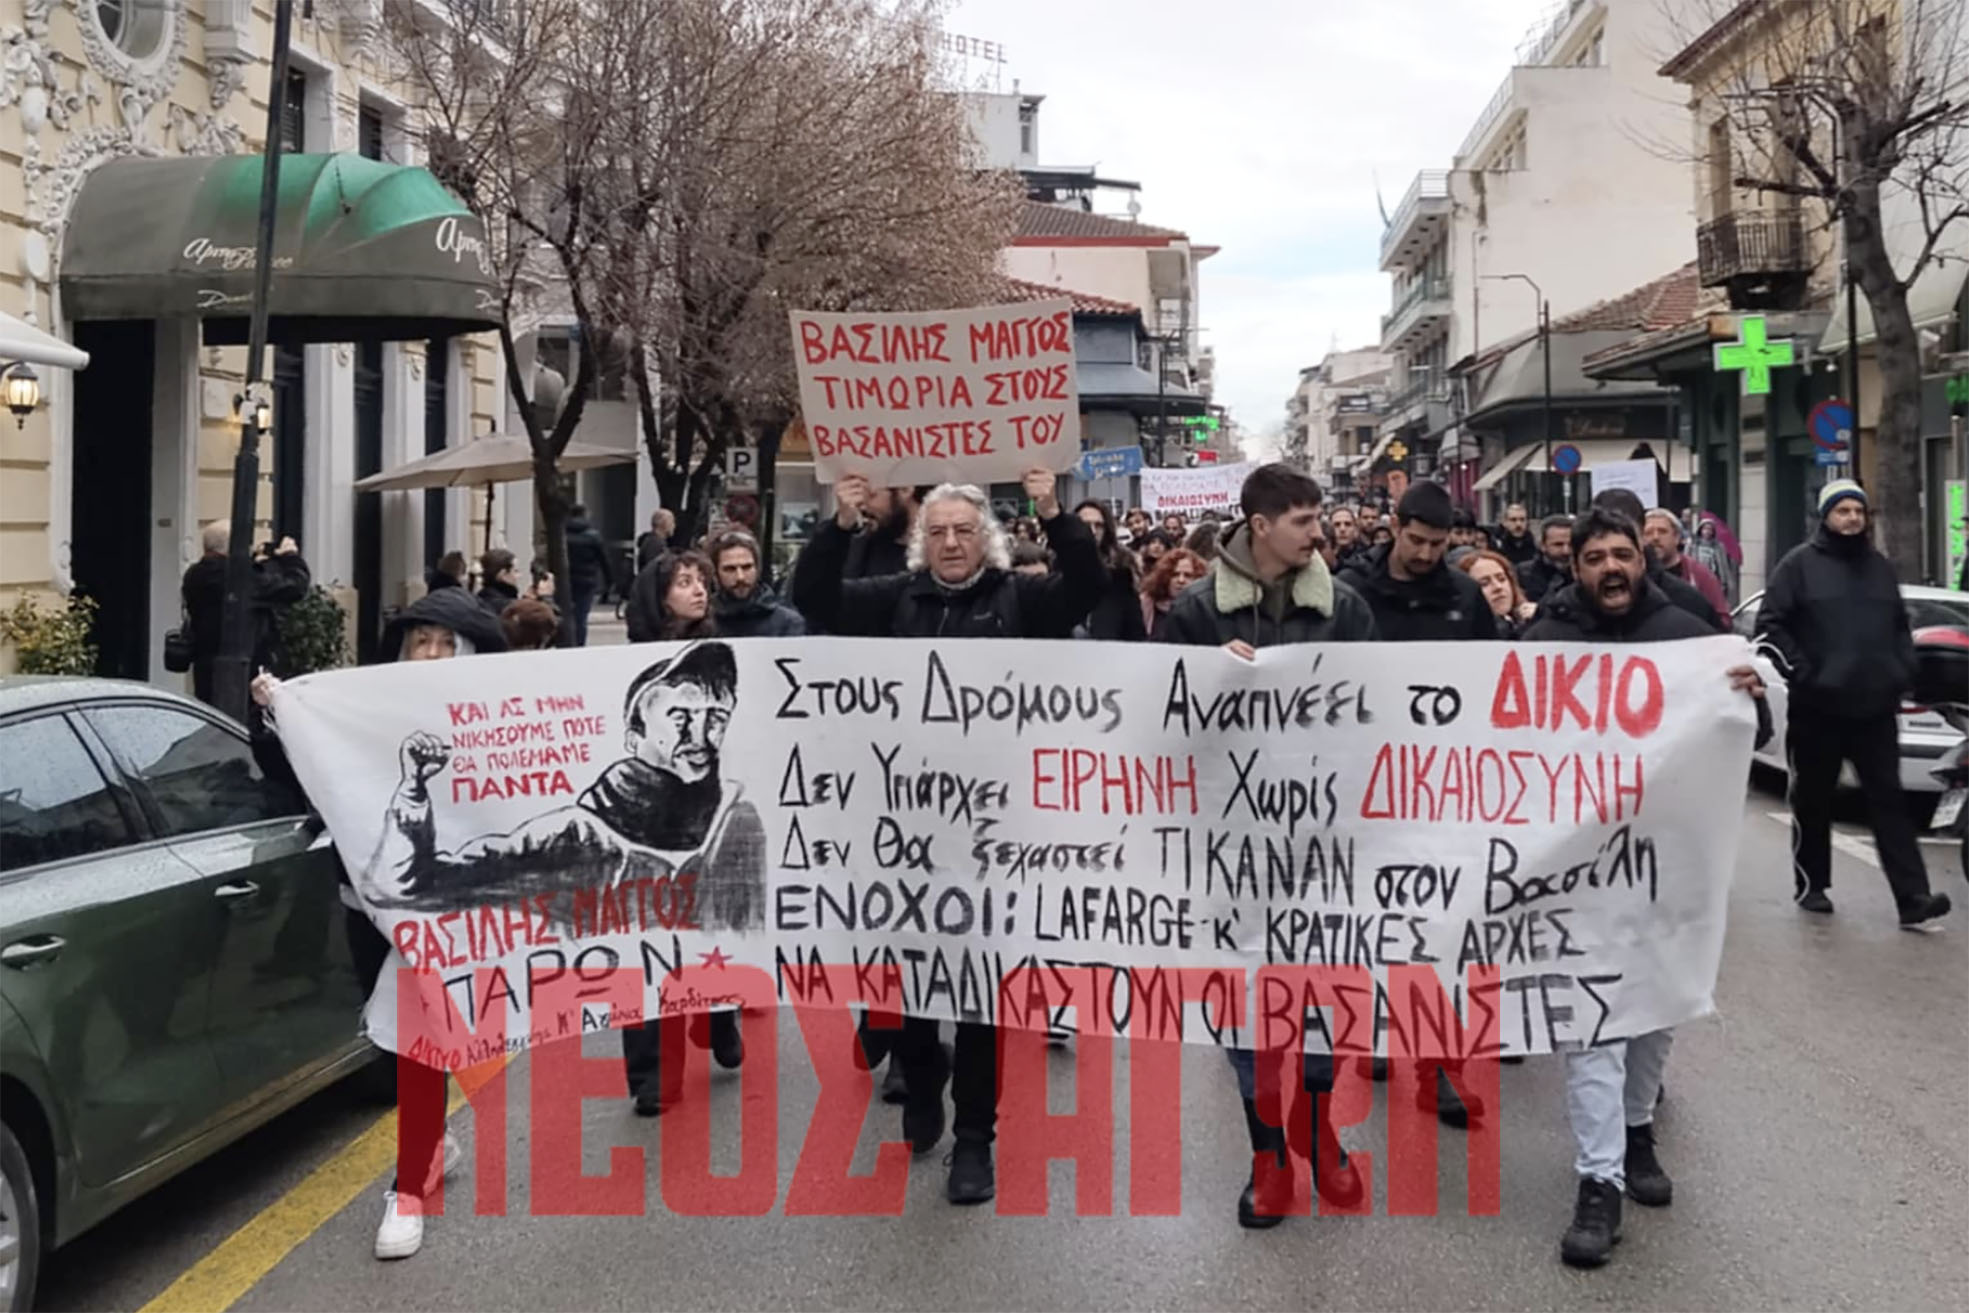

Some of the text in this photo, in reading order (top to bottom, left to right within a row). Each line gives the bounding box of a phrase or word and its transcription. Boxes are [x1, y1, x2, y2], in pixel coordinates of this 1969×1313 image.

[941, 31, 1008, 63] HOTEL
[801, 312, 1071, 364] ΒΑΣΙΛΗΣ ΜΑΓΓΟΣ
[814, 364, 1069, 410] ΤΙΜΩΡΙΑ ΣΤΟΥΣ
[813, 412, 1064, 459] ΒΑΣΑΝΙΣΤΕΣ ΤΟΥ
[446, 694, 585, 725] ΚΑΙ ΑΣ ΜΗΝ
[775, 649, 1665, 739] Στους Δρόμους Αναπνέει το ΔΙΚΙΟ
[453, 715, 606, 749] ΝΙΚΗΣΟΥΜΕ ΠΟΤΕ
[453, 743, 591, 773] ΘΑ ΠΟΛΕΜΑΜΕ
[452, 770, 575, 803] ΠΑΝΤΑ
[779, 741, 1644, 837] Δεν Υπάρχει ΕΙΡΗΝΗ Χωρίς ΔΙΚΑΙΟΣΥΝΗ
[779, 811, 851, 870] Δεν
[1206, 828, 1355, 907] ΚΑΝΑΝ
[1374, 863, 1462, 910] στον
[1485, 824, 1658, 915] Βασίλη
[393, 873, 700, 975] ΒΑΣΙΛΗΣ ΜΑΓΓΟΣ
[775, 879, 1018, 937] ΕΝΟΧΟΙ:
[1265, 907, 1441, 972] ΚΡΑΤΙΚΕΣ
[1457, 908, 1587, 976] ΑΡΧΕΣ
[442, 933, 684, 1033] ΠΑΡΩΝ
[775, 944, 1623, 1060] ΝΑ ΚΑΤΑΔΙΚΑΣΤΟΥΝ ΟΙ ΒΑΣΑΝΙΣΤΕΣ
